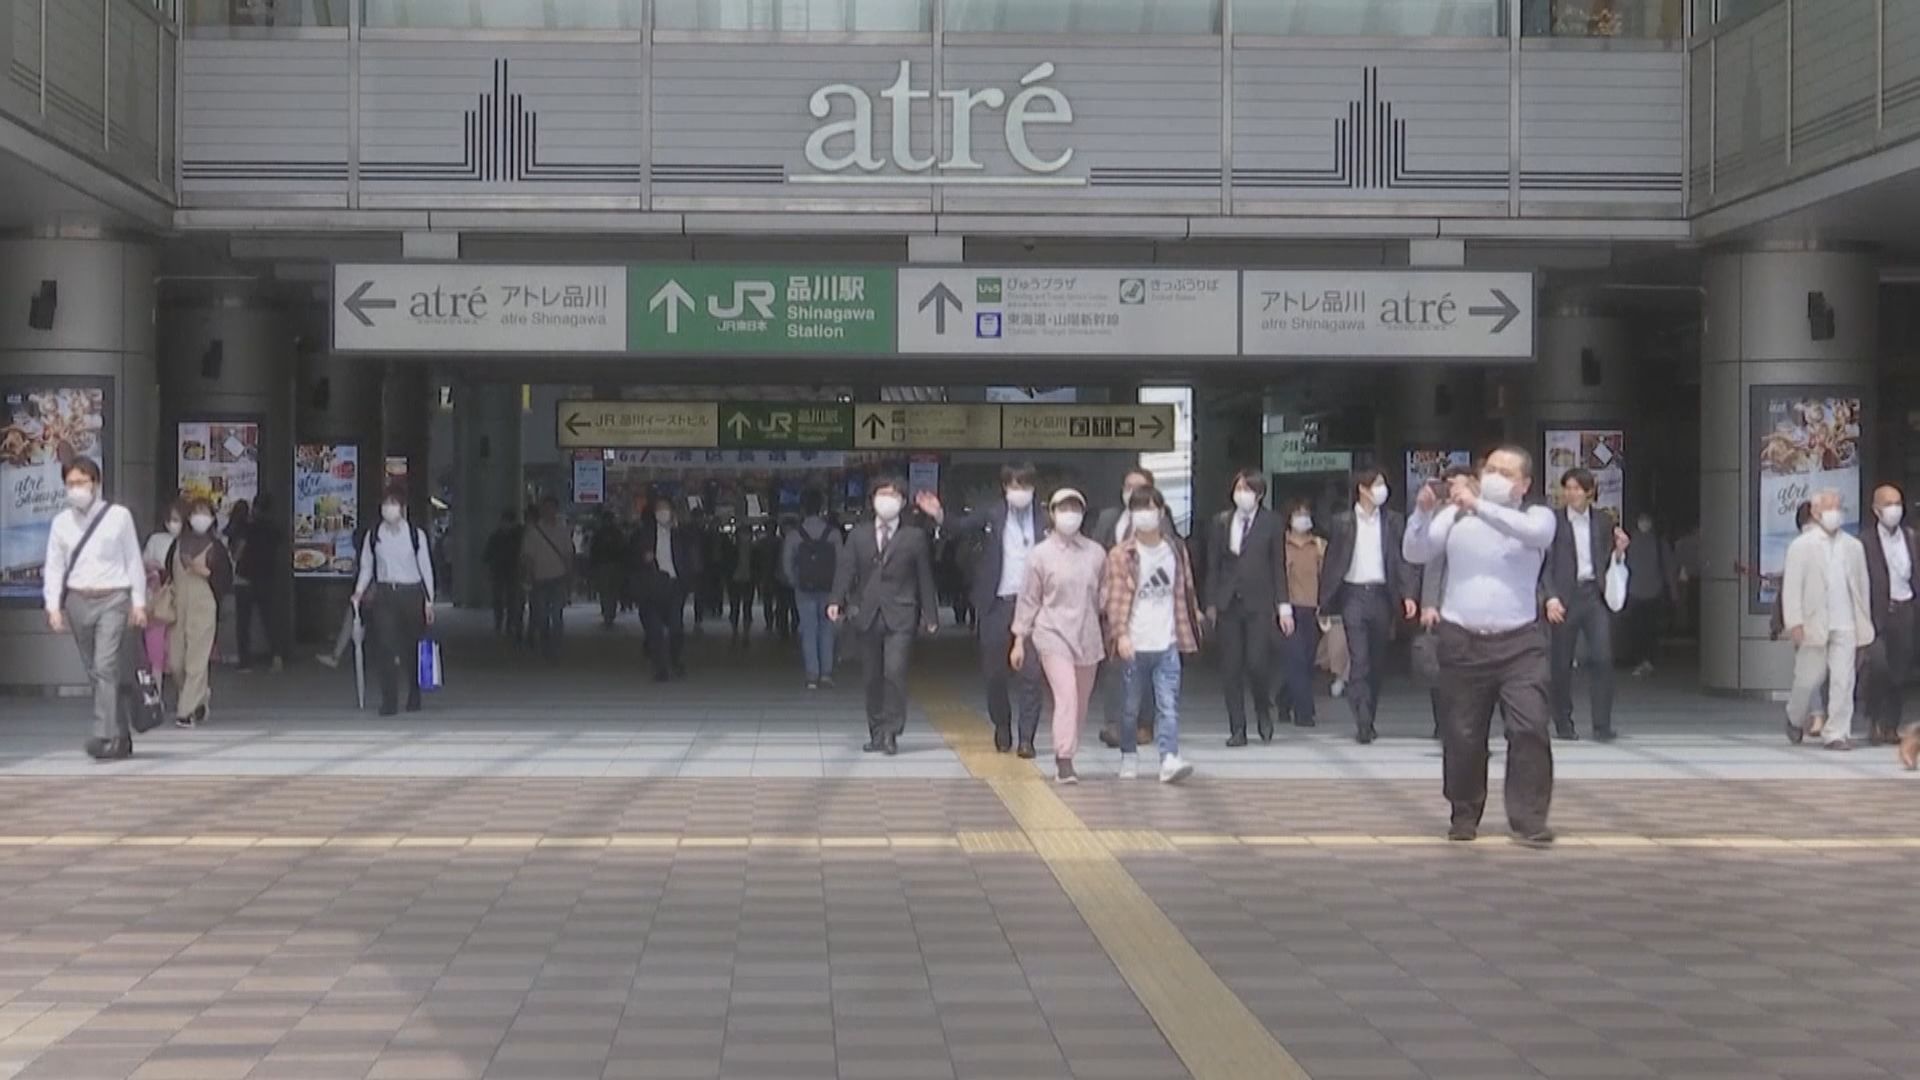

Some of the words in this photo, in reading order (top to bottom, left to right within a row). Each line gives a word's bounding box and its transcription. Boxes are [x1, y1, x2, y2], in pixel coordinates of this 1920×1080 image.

[804, 59, 1074, 172] atré
[501, 285, 607, 308] アトレ品川
[707, 280, 775, 319] JR
[787, 276, 865, 301] 品川駅
[410, 284, 488, 319] atré
[1261, 290, 1365, 312] アトレ品川
[1380, 291, 1457, 325] atré
[532, 312, 606, 327] Shinagawa
[787, 305, 875, 323] Shinagawa
[1291, 317, 1365, 332] Shinagawa
[787, 324, 844, 338] Station
